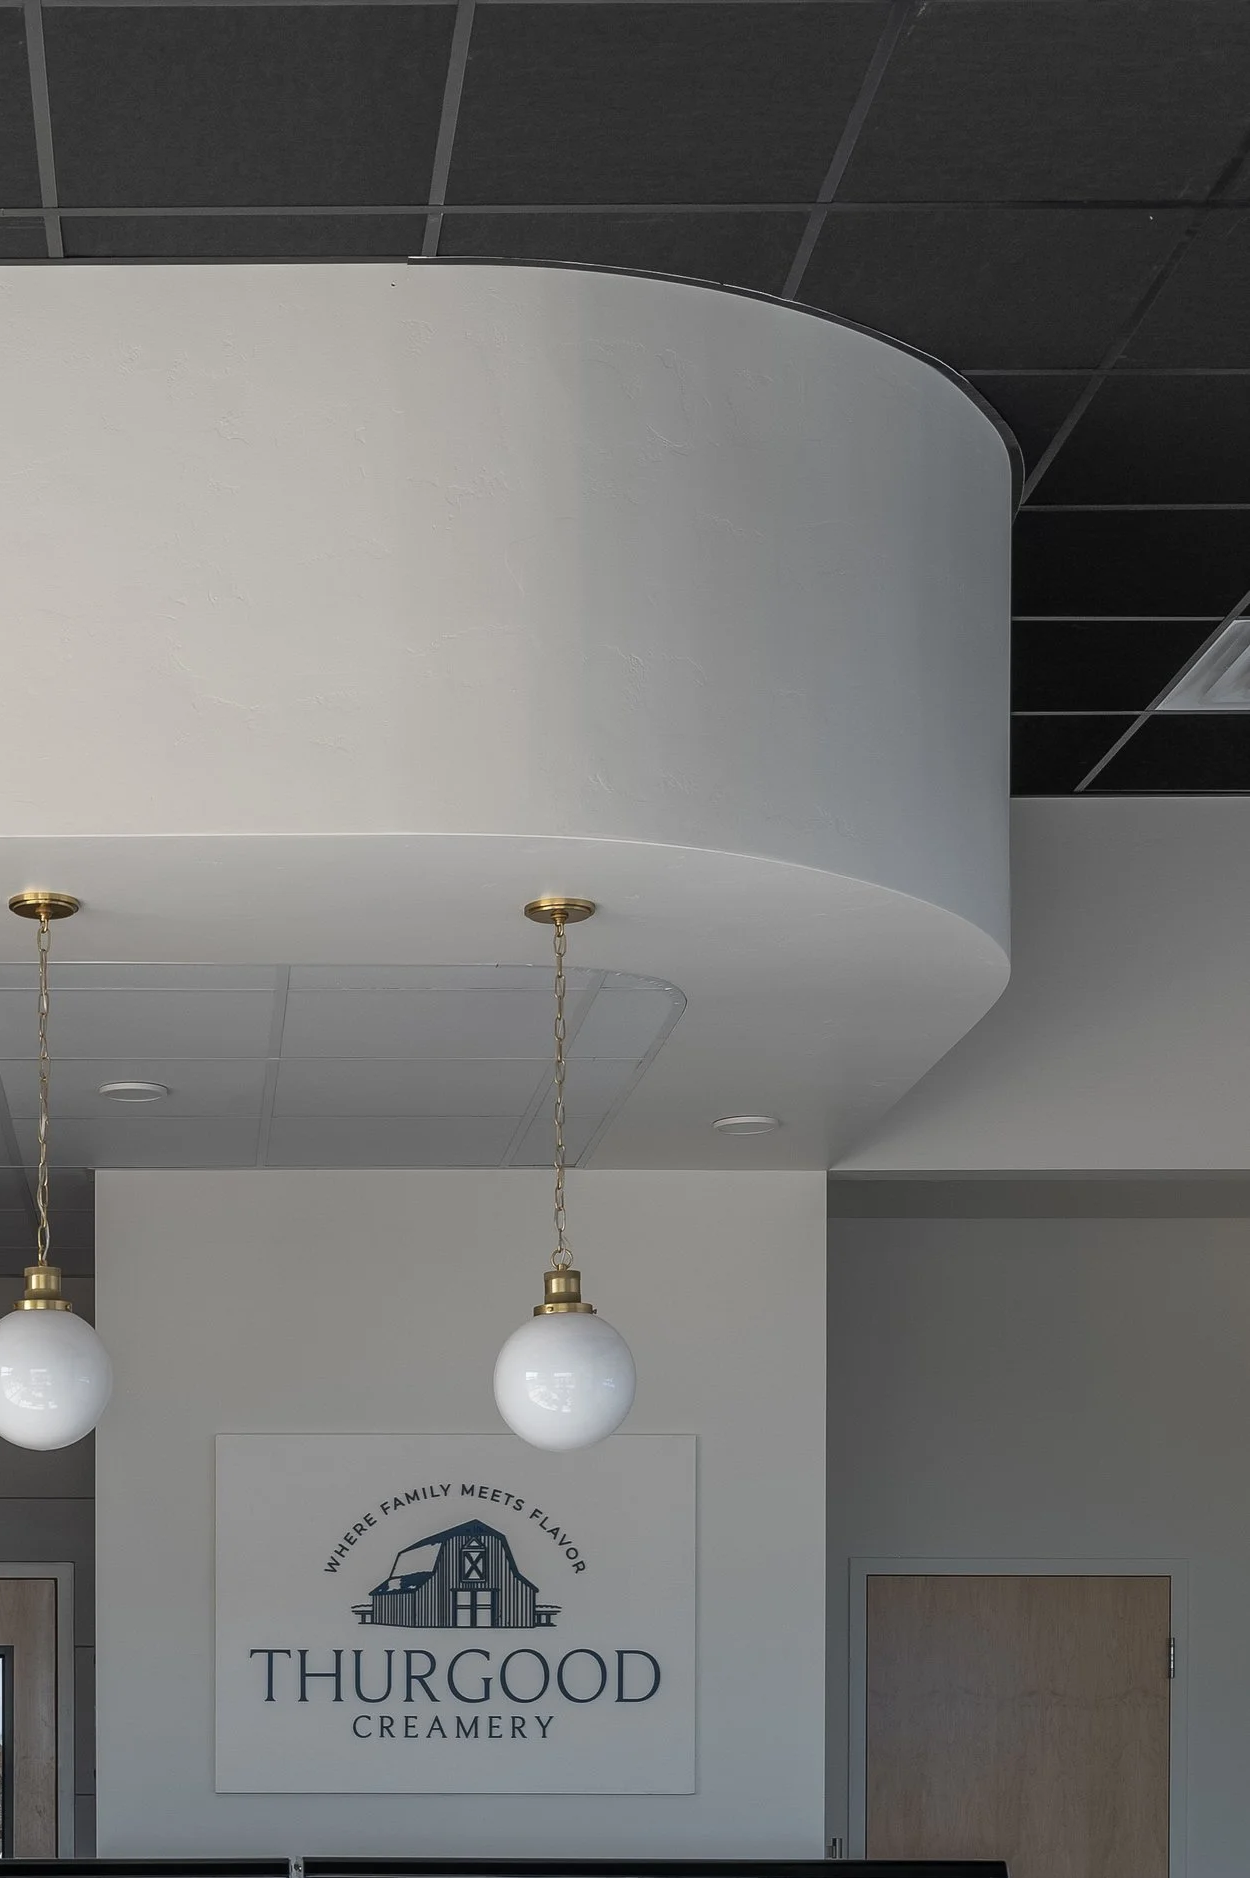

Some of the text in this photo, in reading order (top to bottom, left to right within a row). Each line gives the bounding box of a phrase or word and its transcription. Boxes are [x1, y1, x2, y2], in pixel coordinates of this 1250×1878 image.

[324, 1483, 586, 1574] WHERE FAMILY MEETS FLAVOR
[249, 1648, 661, 1704] THURGOOD
[352, 1714, 555, 1739] CREAMERY
